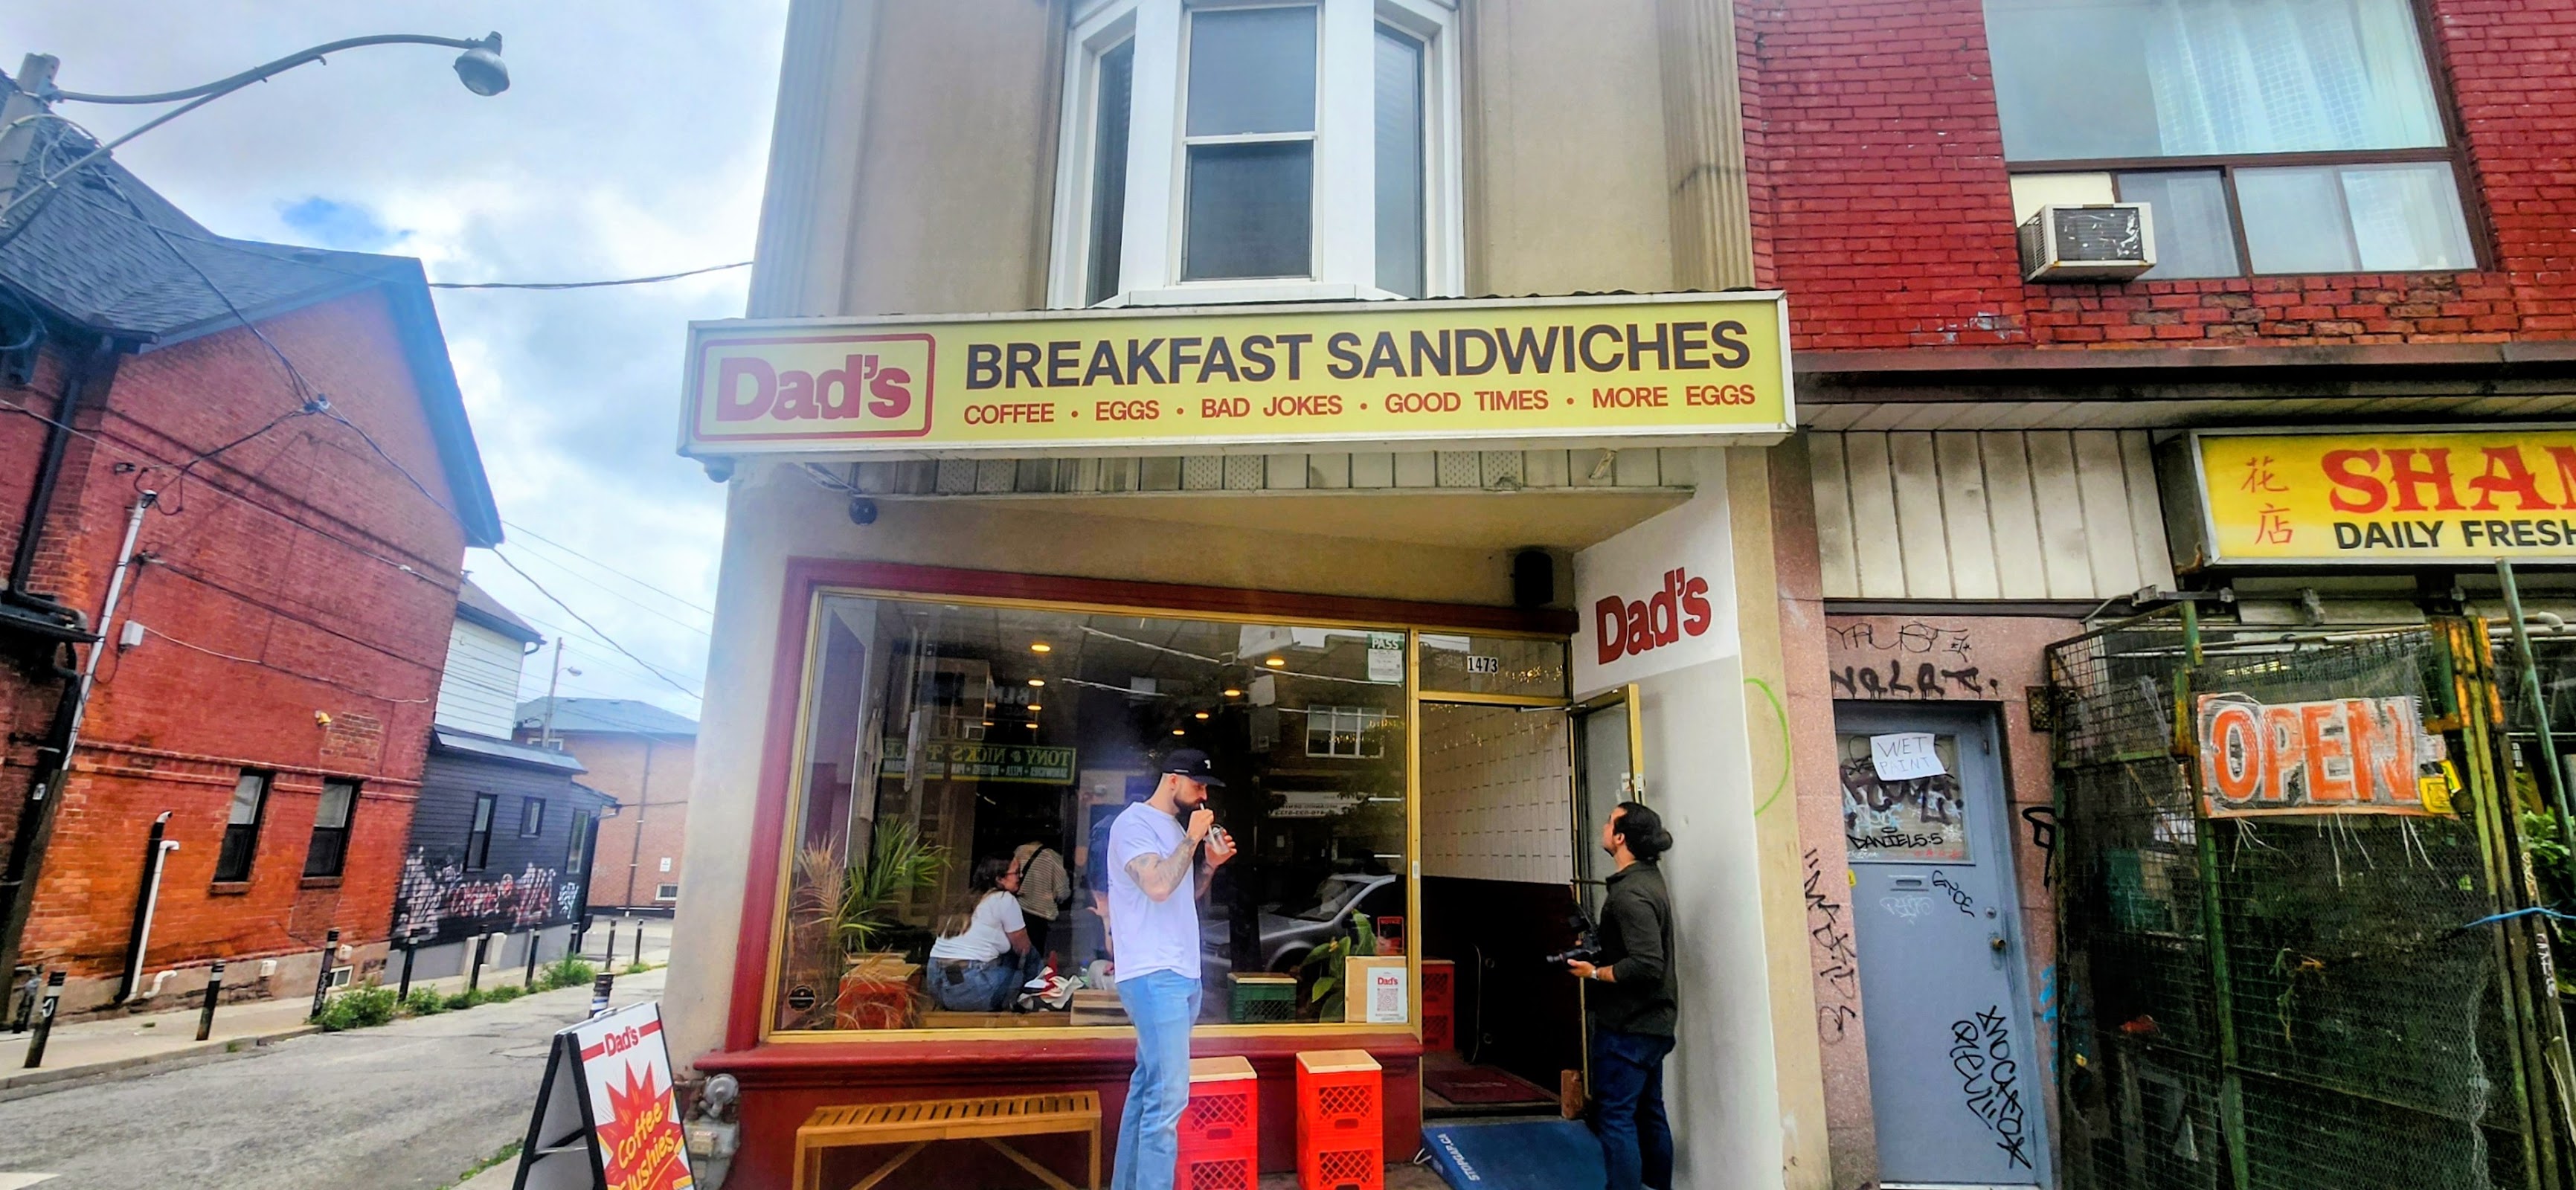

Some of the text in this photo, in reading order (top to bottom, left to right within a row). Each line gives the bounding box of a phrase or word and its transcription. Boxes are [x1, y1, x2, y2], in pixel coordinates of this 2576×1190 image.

[966, 321, 1751, 390] BREAKFAST SANDWICHES
[714, 354, 912, 422] Dad's
[964, 384, 1756, 425] COFFEE EGGS BAD JOKES GOOD TIMES MORE EGGS
[2241, 455, 2293, 546] 花店
[2333, 521, 2445, 550] DAILY
[1596, 566, 1712, 665] Dad's
[1372, 638, 1399, 650] PASS
[1468, 657, 1498, 673] 1473
[1876, 736, 1928, 758] WET
[1879, 756, 1932, 776] PAINT
[2211, 699, 2419, 803] OPEN
[1378, 977, 1398, 985] Dad's
[604, 1025, 640, 1057] Dad's
[618, 1101, 664, 1169] Coffee
[1437, 1133, 1481, 1181] STOPGAP.CA
